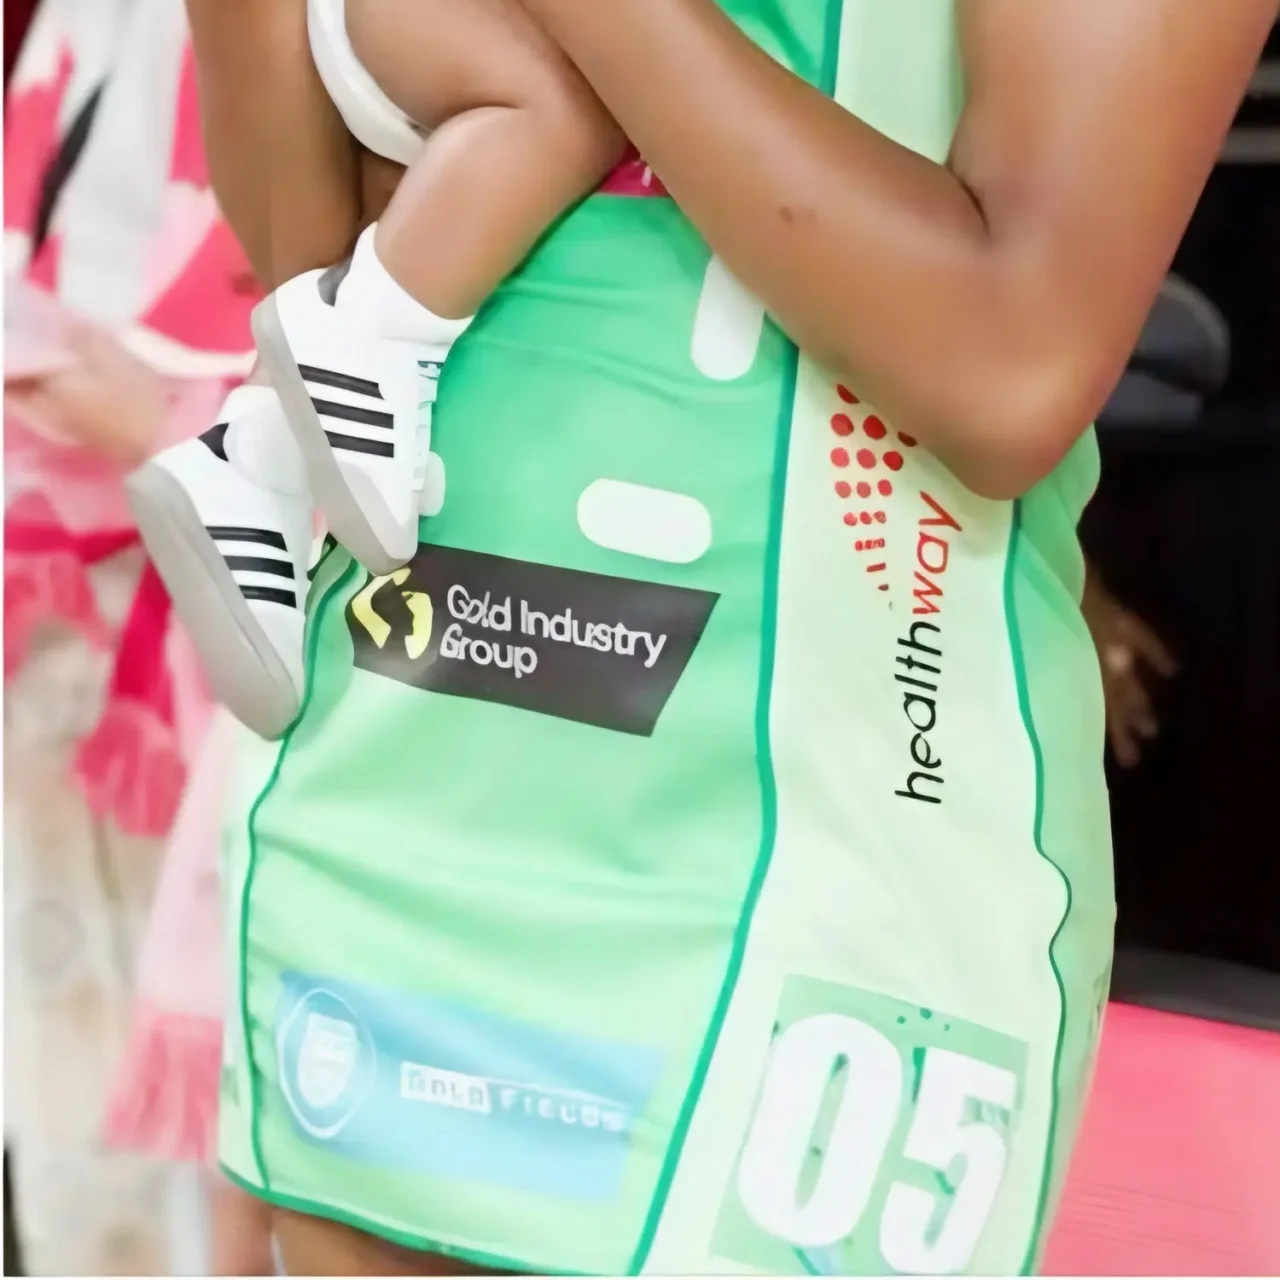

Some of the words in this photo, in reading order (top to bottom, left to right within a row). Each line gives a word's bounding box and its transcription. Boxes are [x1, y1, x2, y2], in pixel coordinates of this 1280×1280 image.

[439, 623, 539, 679] Group
[447, 584, 512, 632] Gold
[520, 599, 668, 669] Industry
[894, 490, 963, 805] healthway
[736, 1012, 1020, 1276] 05
